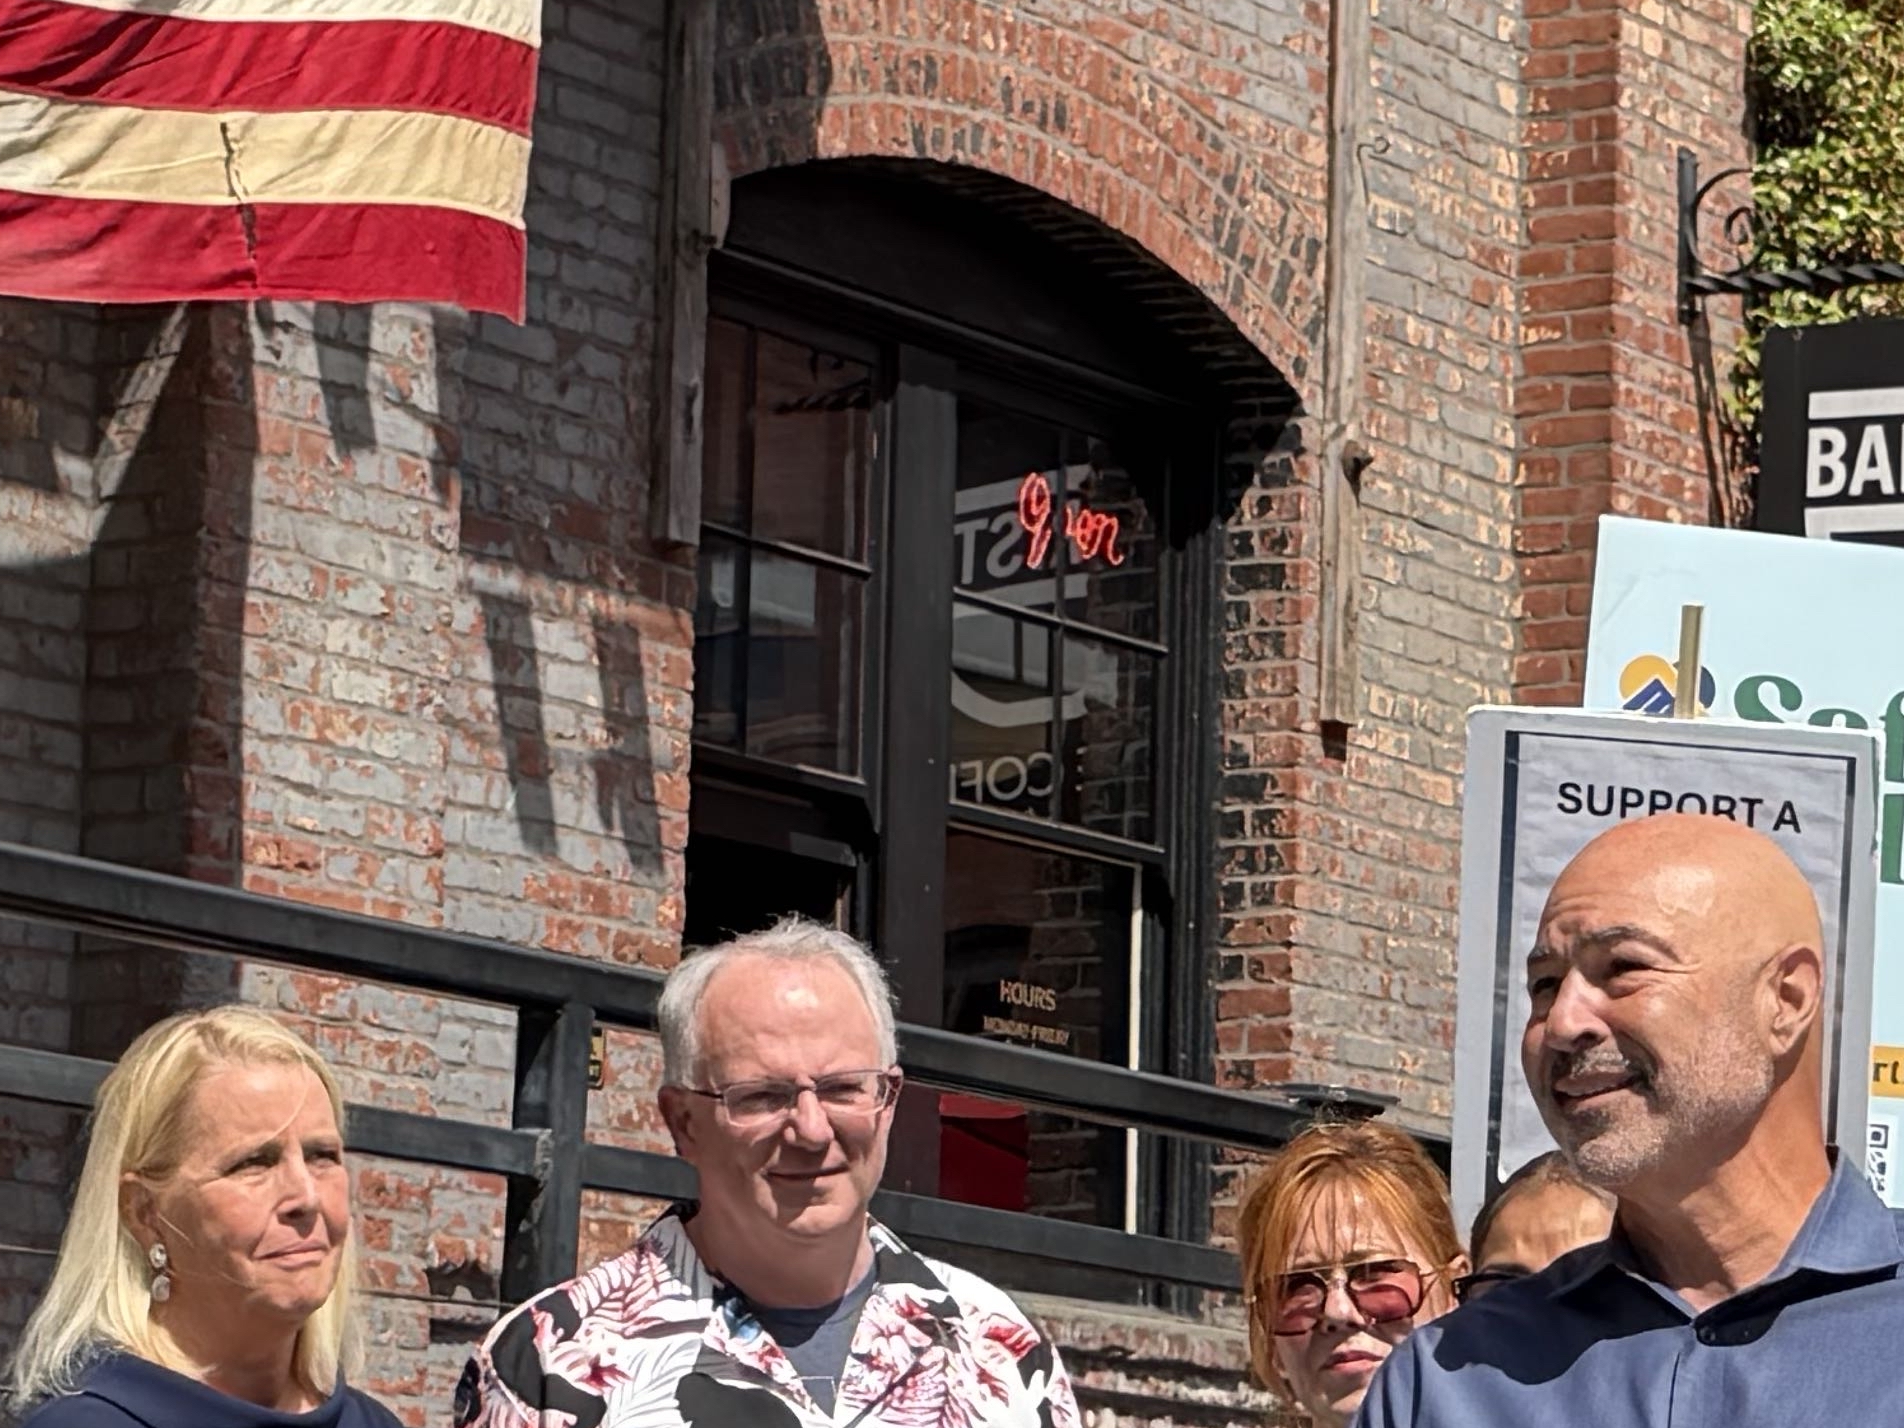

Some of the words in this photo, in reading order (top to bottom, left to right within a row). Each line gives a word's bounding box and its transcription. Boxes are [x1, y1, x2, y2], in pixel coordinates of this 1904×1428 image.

[1557, 781, 1763, 829] SUPPORT
[1772, 800, 1801, 834] A
[1000, 979, 1056, 1011] HOURS
